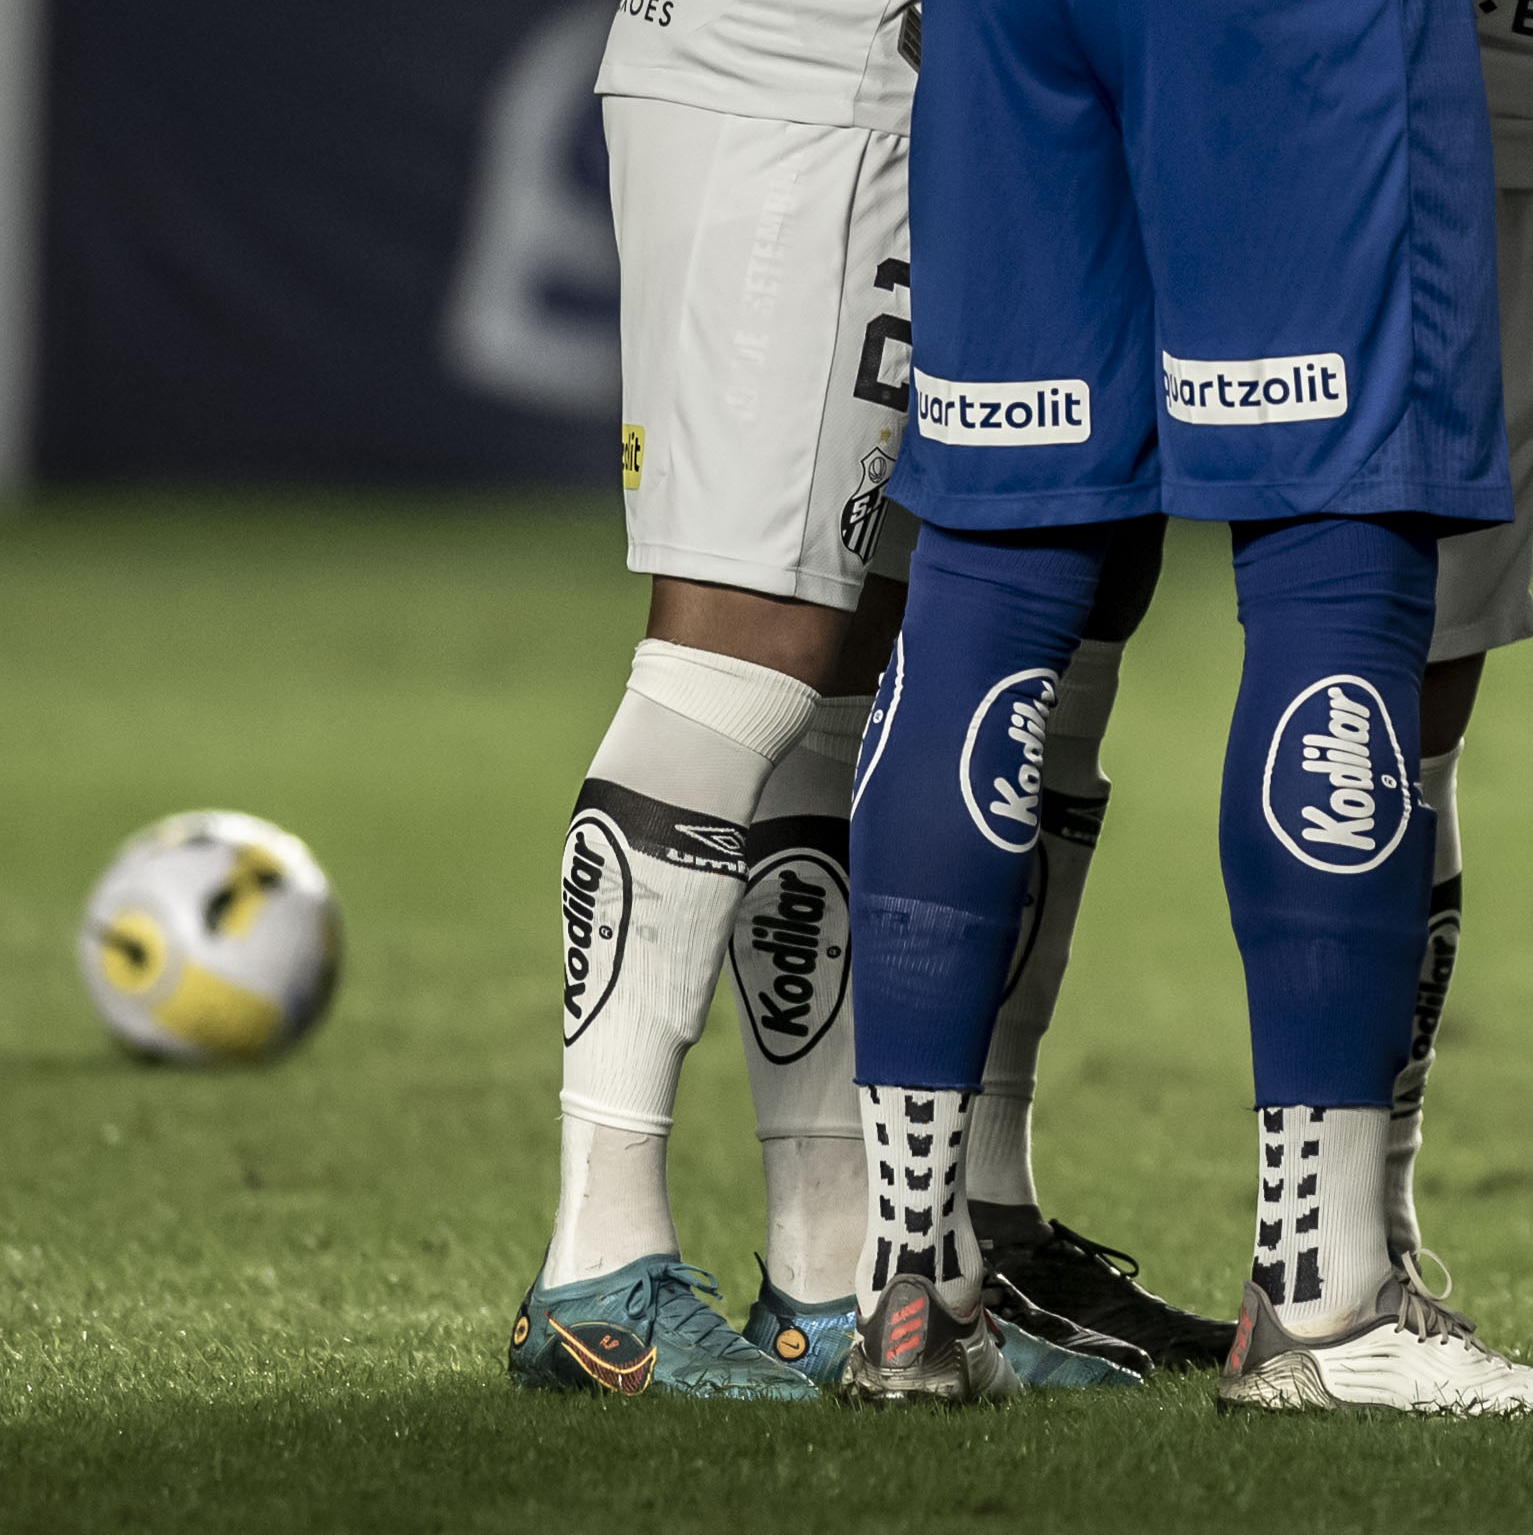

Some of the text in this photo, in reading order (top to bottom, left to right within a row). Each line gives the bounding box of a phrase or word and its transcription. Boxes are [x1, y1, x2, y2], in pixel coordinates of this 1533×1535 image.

[917, 388, 1083, 429] uartzolit
[1302, 686, 1377, 851] Kodilar
[562, 831, 605, 1020] Kodilar
[752, 869, 827, 1038] Kodilar
[1411, 935, 1455, 1061] odilar
